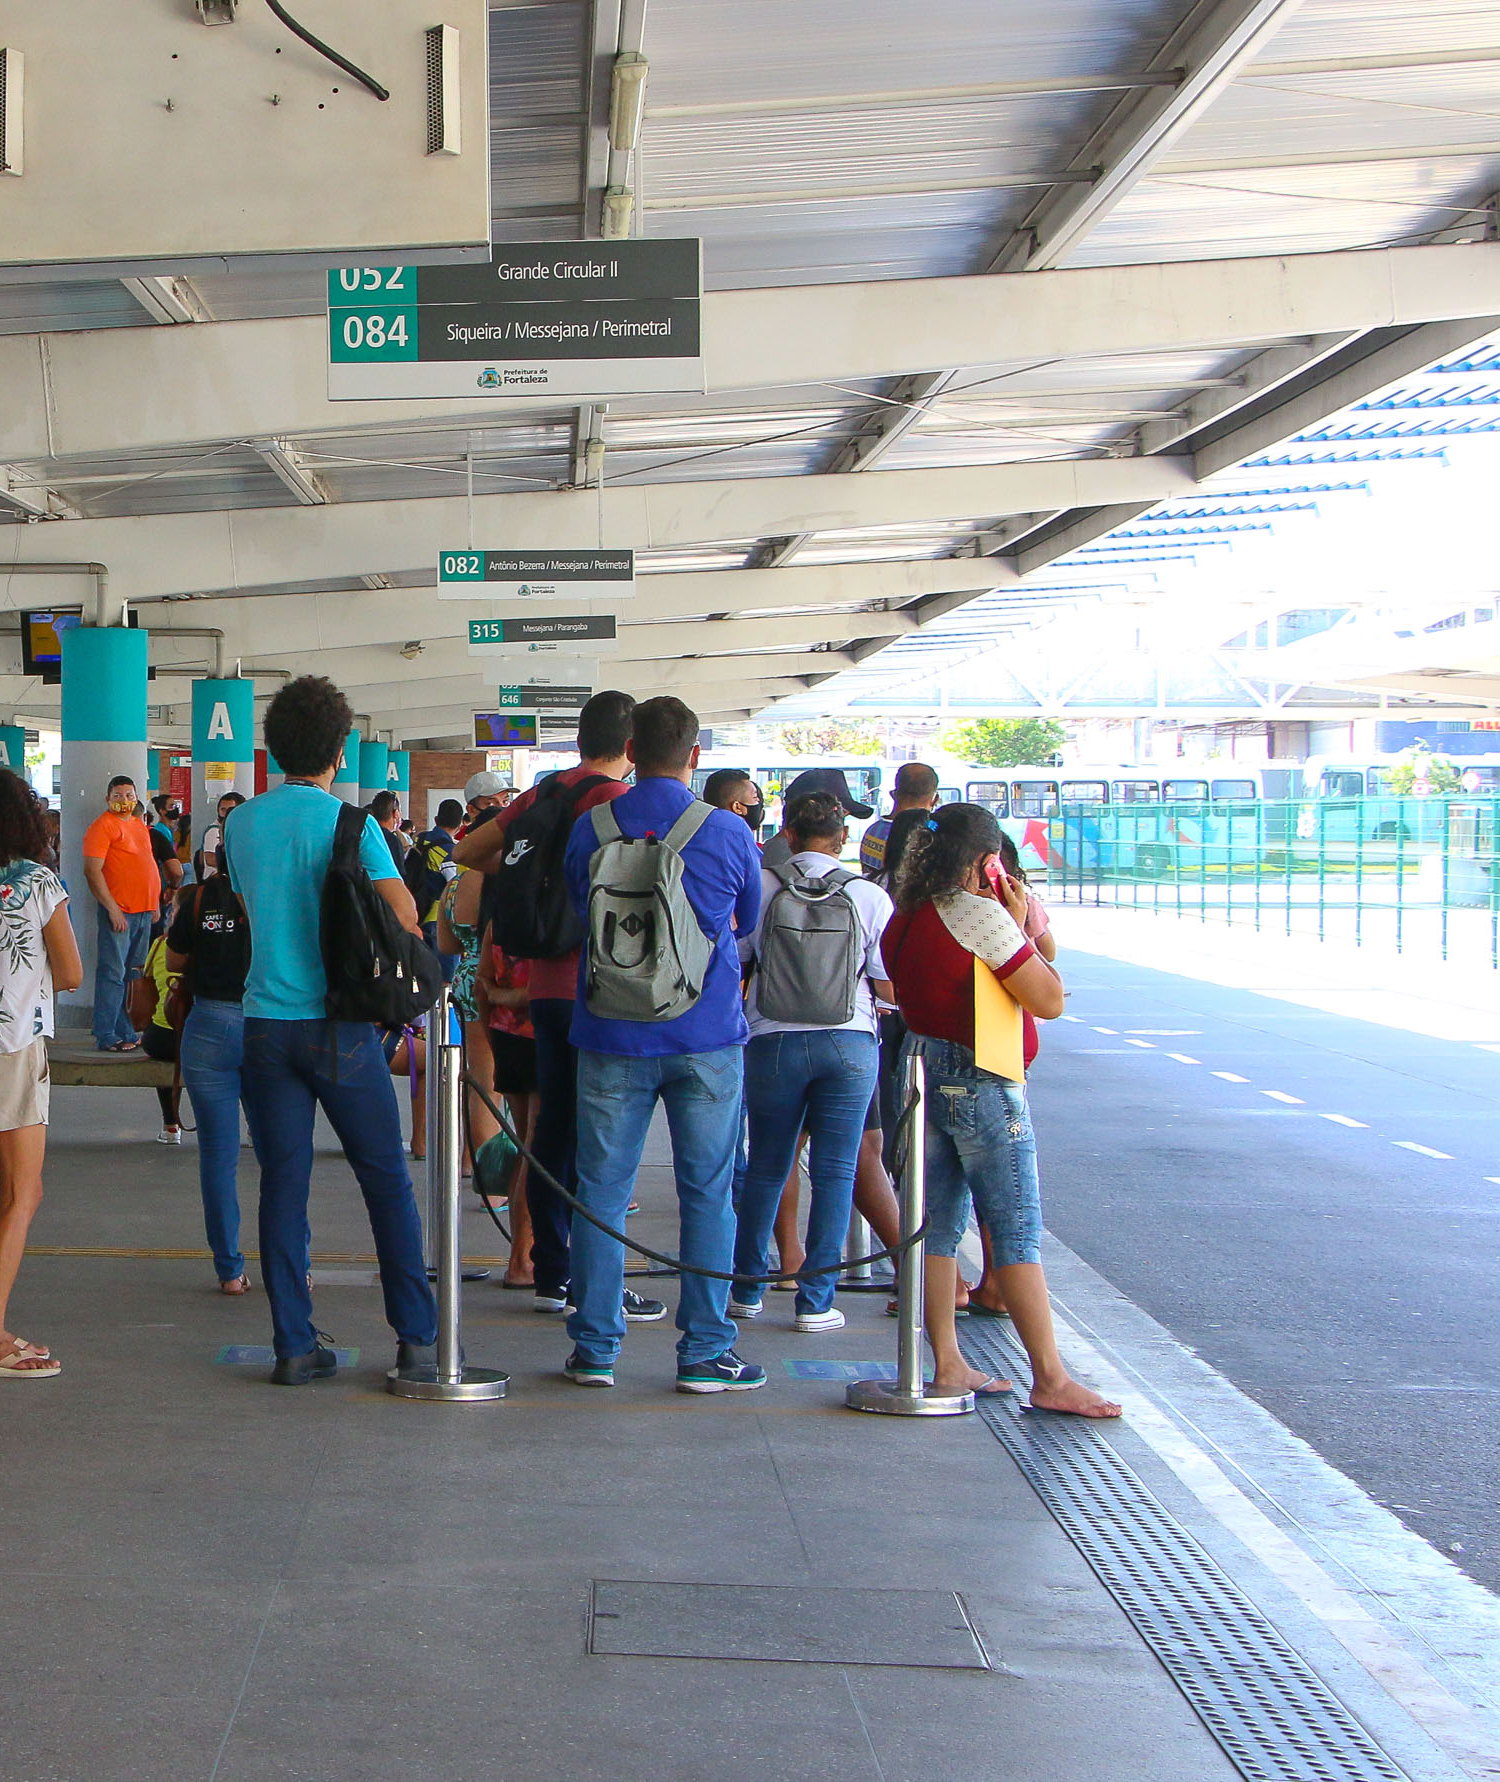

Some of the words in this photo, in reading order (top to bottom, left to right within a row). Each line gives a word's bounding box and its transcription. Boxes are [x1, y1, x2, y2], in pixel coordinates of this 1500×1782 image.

[340, 267, 404, 290] 052
[498, 262, 549, 280] Grande
[553, 261, 606, 279] Circular
[343, 315, 409, 348] 084
[447, 322, 502, 344] Siqueira
[505, 322, 512, 338] /
[515, 321, 588, 342] Messejana
[593, 320, 598, 336] /
[602, 318, 672, 336] Perimetral
[504, 375, 548, 384] Fortaleza
[444, 556, 480, 574] 082
[489, 560, 517, 571] Antônio
[519, 561, 545, 570] Bezerra
[546, 560, 550, 570] /
[551, 561, 589, 572] Messejana
[589, 560, 594, 570] /
[595, 560, 630, 570] Perimetral
[472, 624, 499, 638] 315
[523, 625, 553, 634] Messejana
[558, 623, 588, 632] Parangaba
[502, 695, 518, 704] 646
[208, 702, 234, 739] A
[387, 762, 399, 781] A
